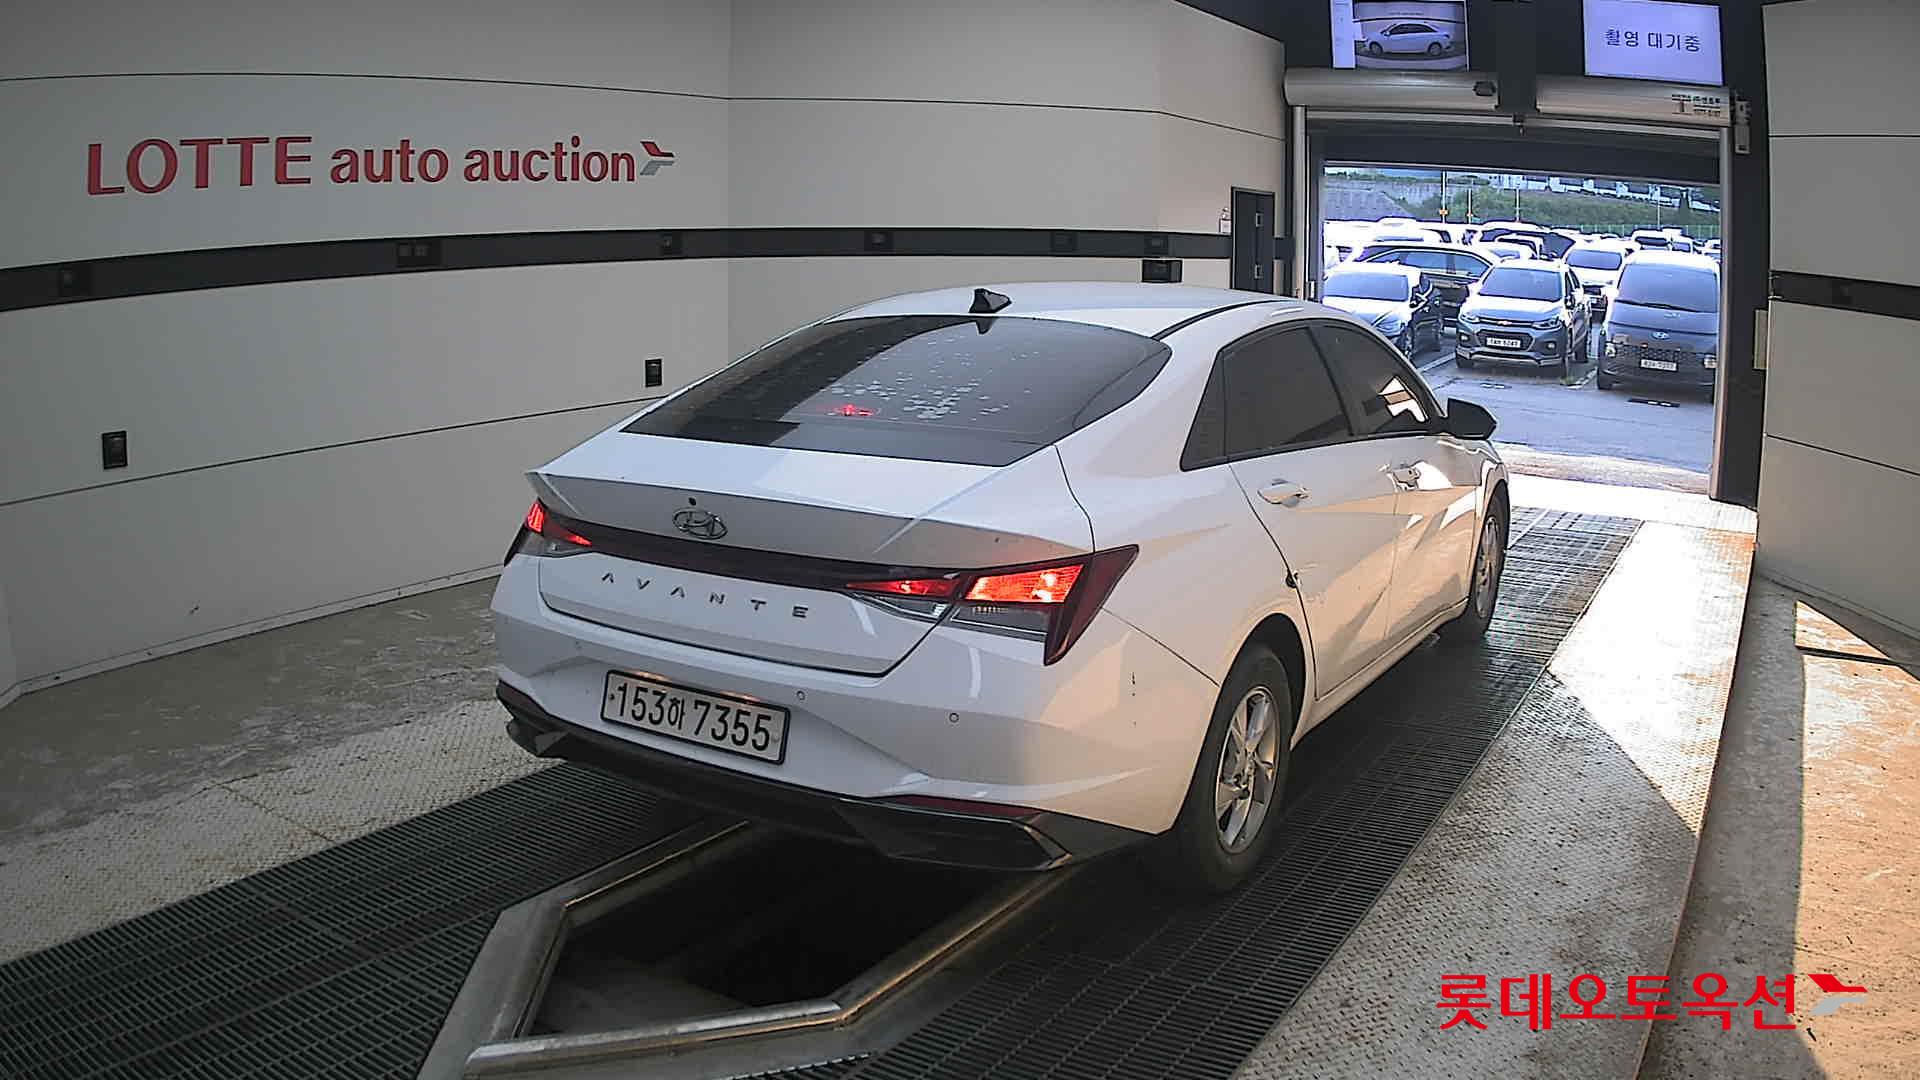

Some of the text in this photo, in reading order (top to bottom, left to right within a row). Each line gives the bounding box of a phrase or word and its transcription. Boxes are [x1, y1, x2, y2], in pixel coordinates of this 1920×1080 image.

[1648, 31, 1700, 53] 대기중
[87, 136, 636, 196] LOTTE auto auction
[601, 571, 809, 619] AVANTE
[617, 682, 772, 751] 153하 7355
